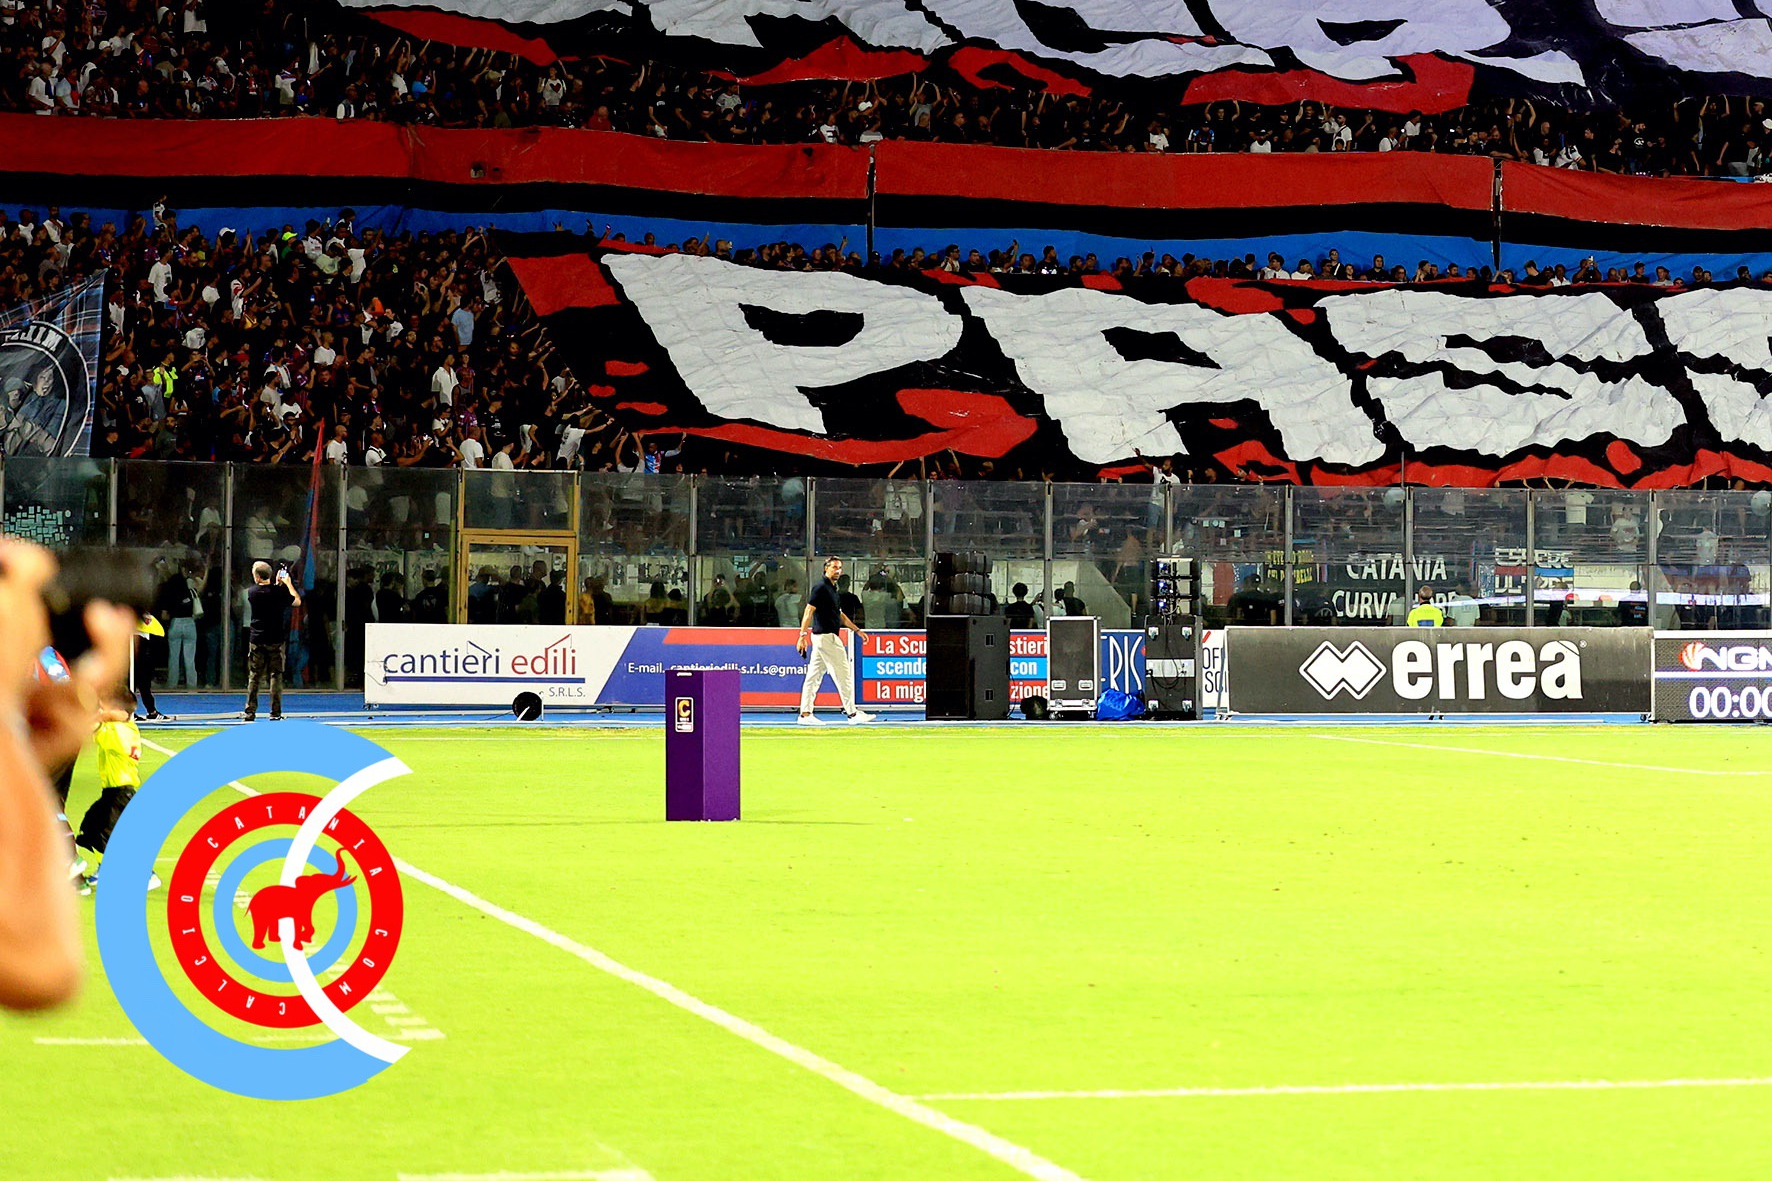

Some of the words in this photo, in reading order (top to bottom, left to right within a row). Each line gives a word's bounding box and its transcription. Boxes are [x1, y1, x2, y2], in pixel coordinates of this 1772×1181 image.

[876, 636, 895, 654] La
[383, 647, 500, 674] cantieri
[511, 645, 576, 675] edili
[1011, 660, 1037, 676] con
[549, 687, 586, 698] S.R.L.S.
[877, 681, 891, 699] la
